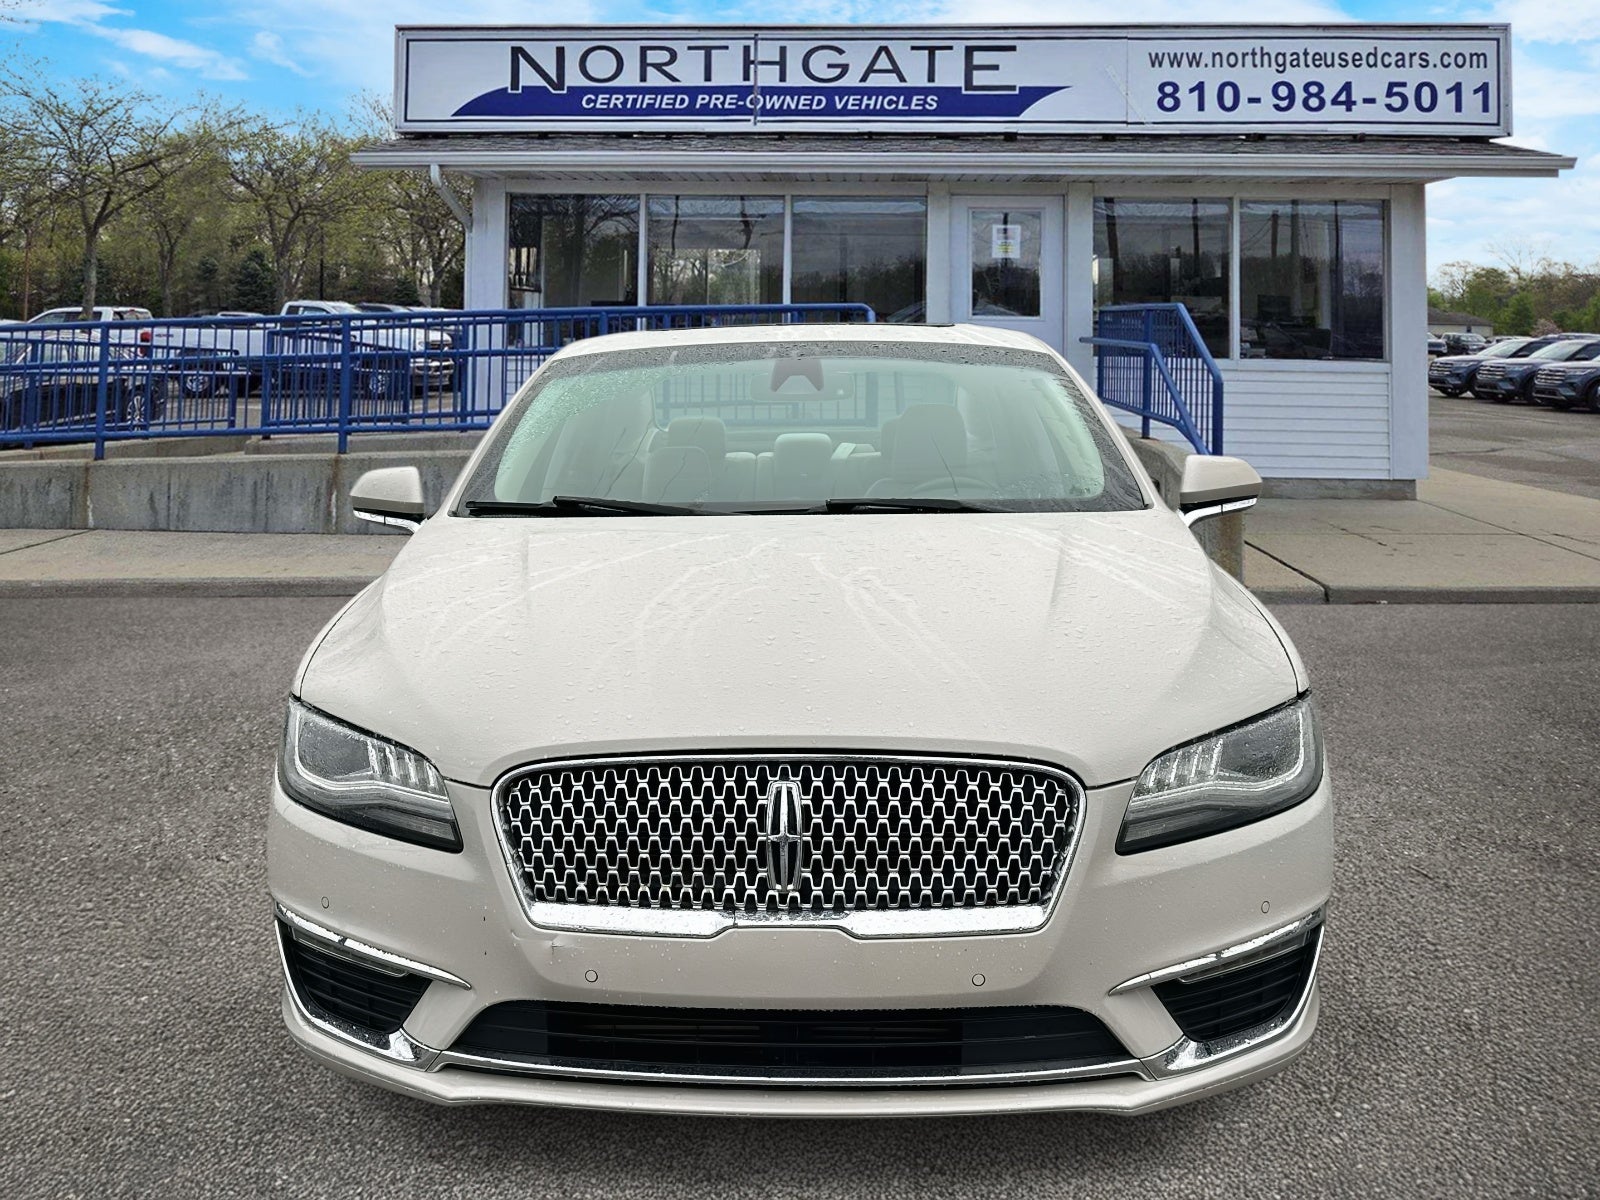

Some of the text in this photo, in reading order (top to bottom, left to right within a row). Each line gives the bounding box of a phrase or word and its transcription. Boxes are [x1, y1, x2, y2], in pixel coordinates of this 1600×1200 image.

[509, 44, 1018, 93] NORTHGATE
[1148, 46, 1488, 74] www.northgateusedcars.com
[581, 93, 939, 112] CERTIFIED PRE-OWNED VEHICLES
[1156, 80, 1491, 113] 810-984-5011
